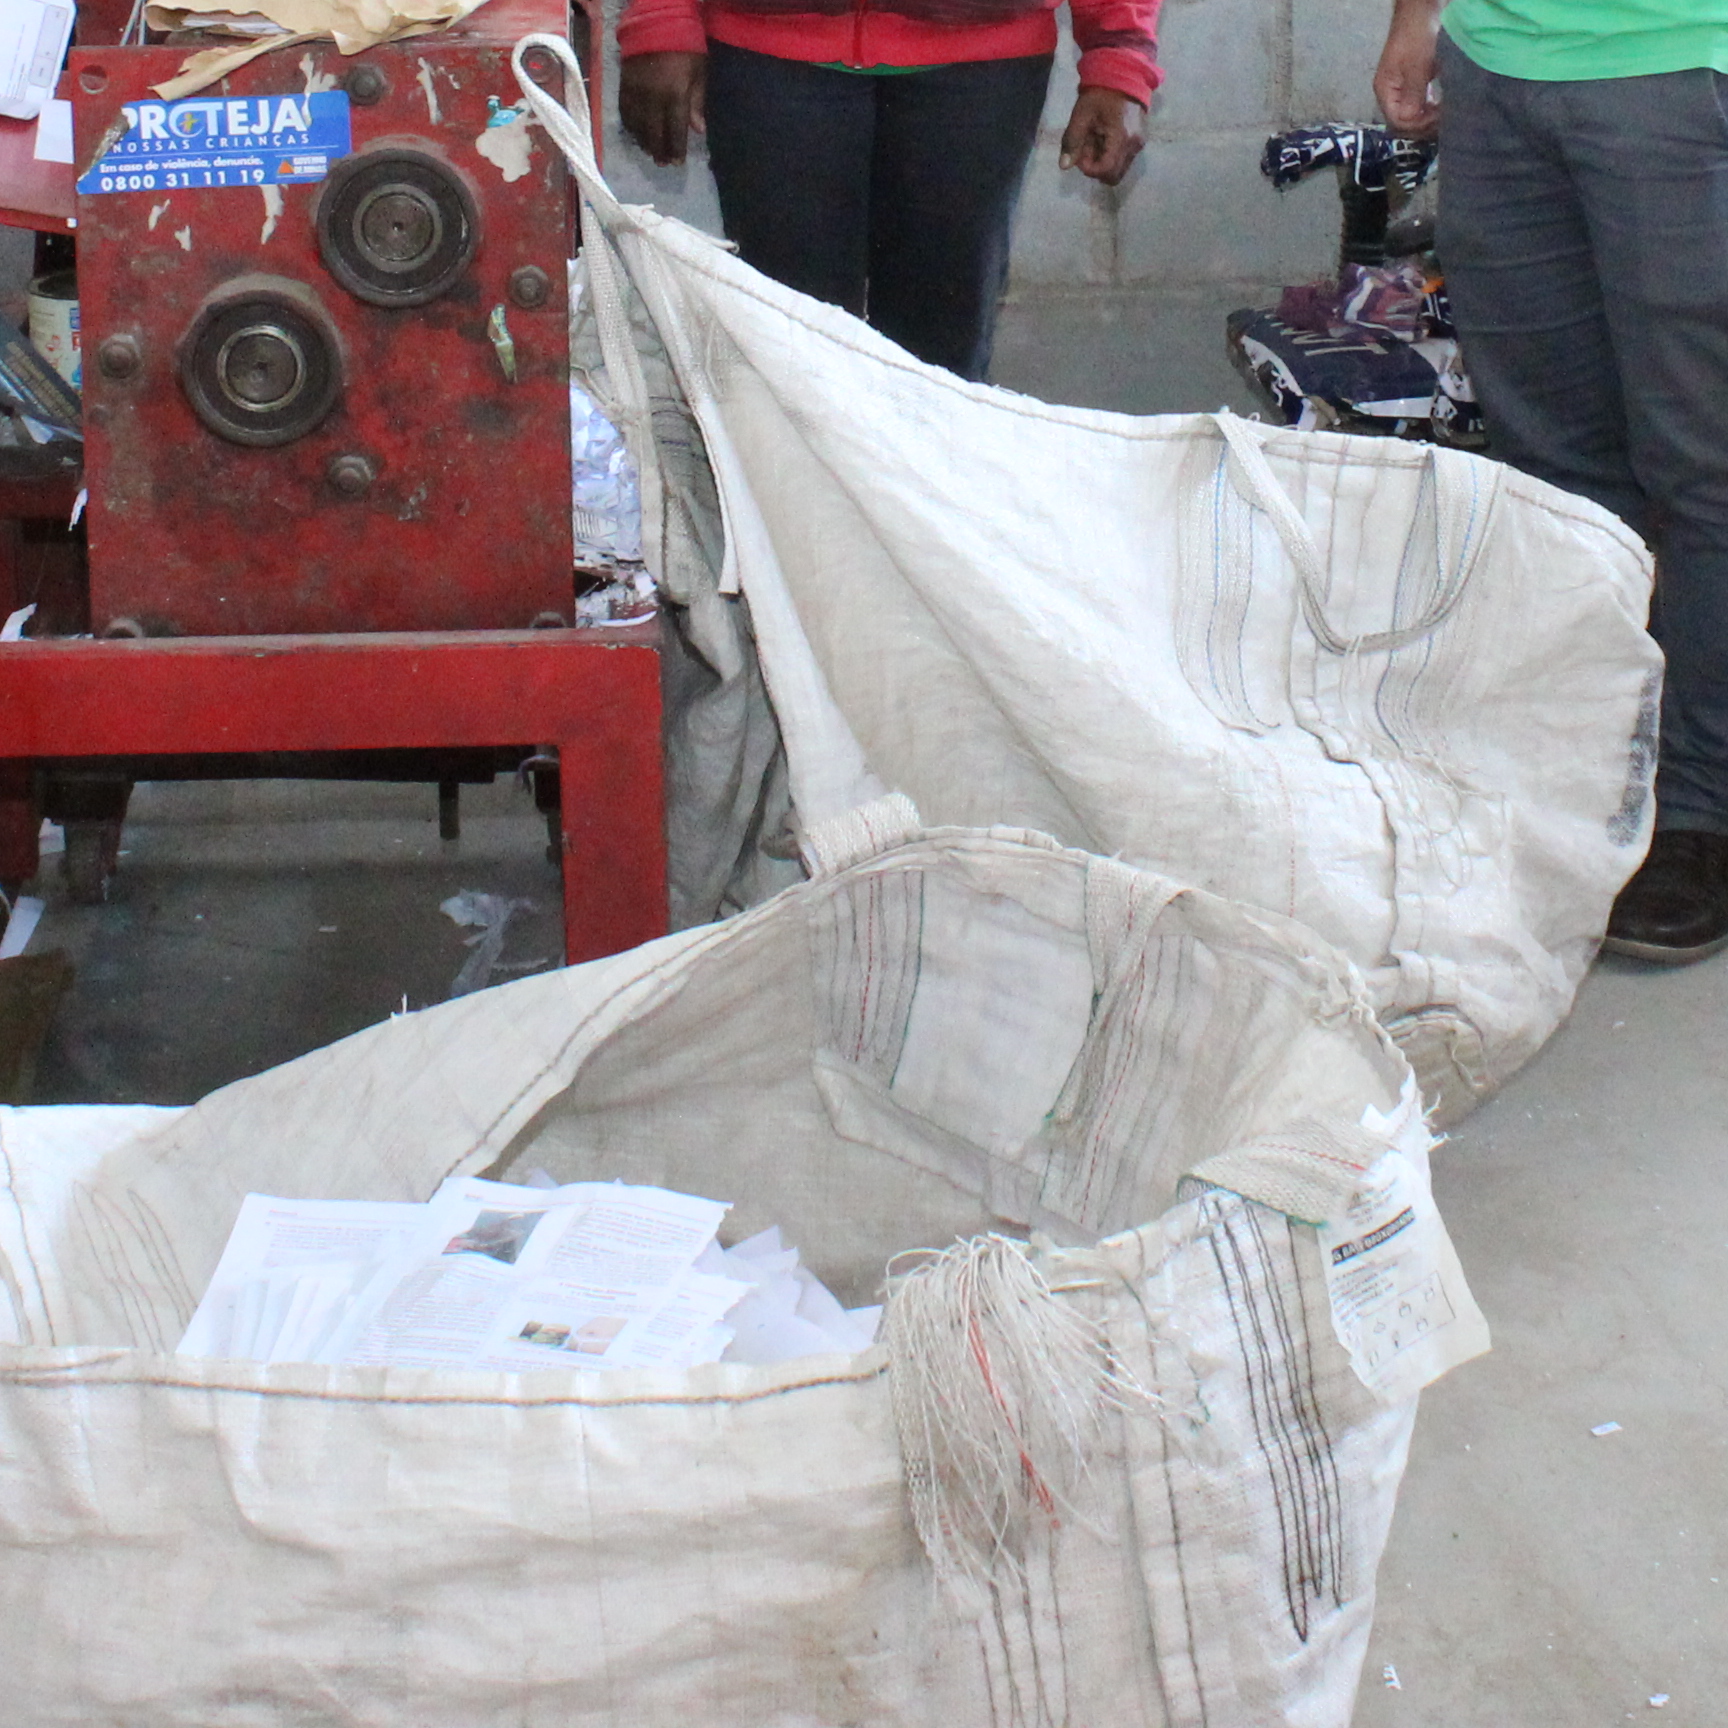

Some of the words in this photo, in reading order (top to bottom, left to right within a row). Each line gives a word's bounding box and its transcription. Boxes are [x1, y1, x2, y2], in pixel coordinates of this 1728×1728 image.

[113, 139, 191, 153] NOSSAS
[205, 133, 310, 150] CRIANÇAS
[99, 163, 117, 173] Em
[118, 162, 144, 172] caso
[144, 159, 159, 171] de
[100, 174, 156, 192] 0800
[165, 172, 189, 188] 31
[204, 170, 227, 185] 11
[240, 168, 266, 184] 19
